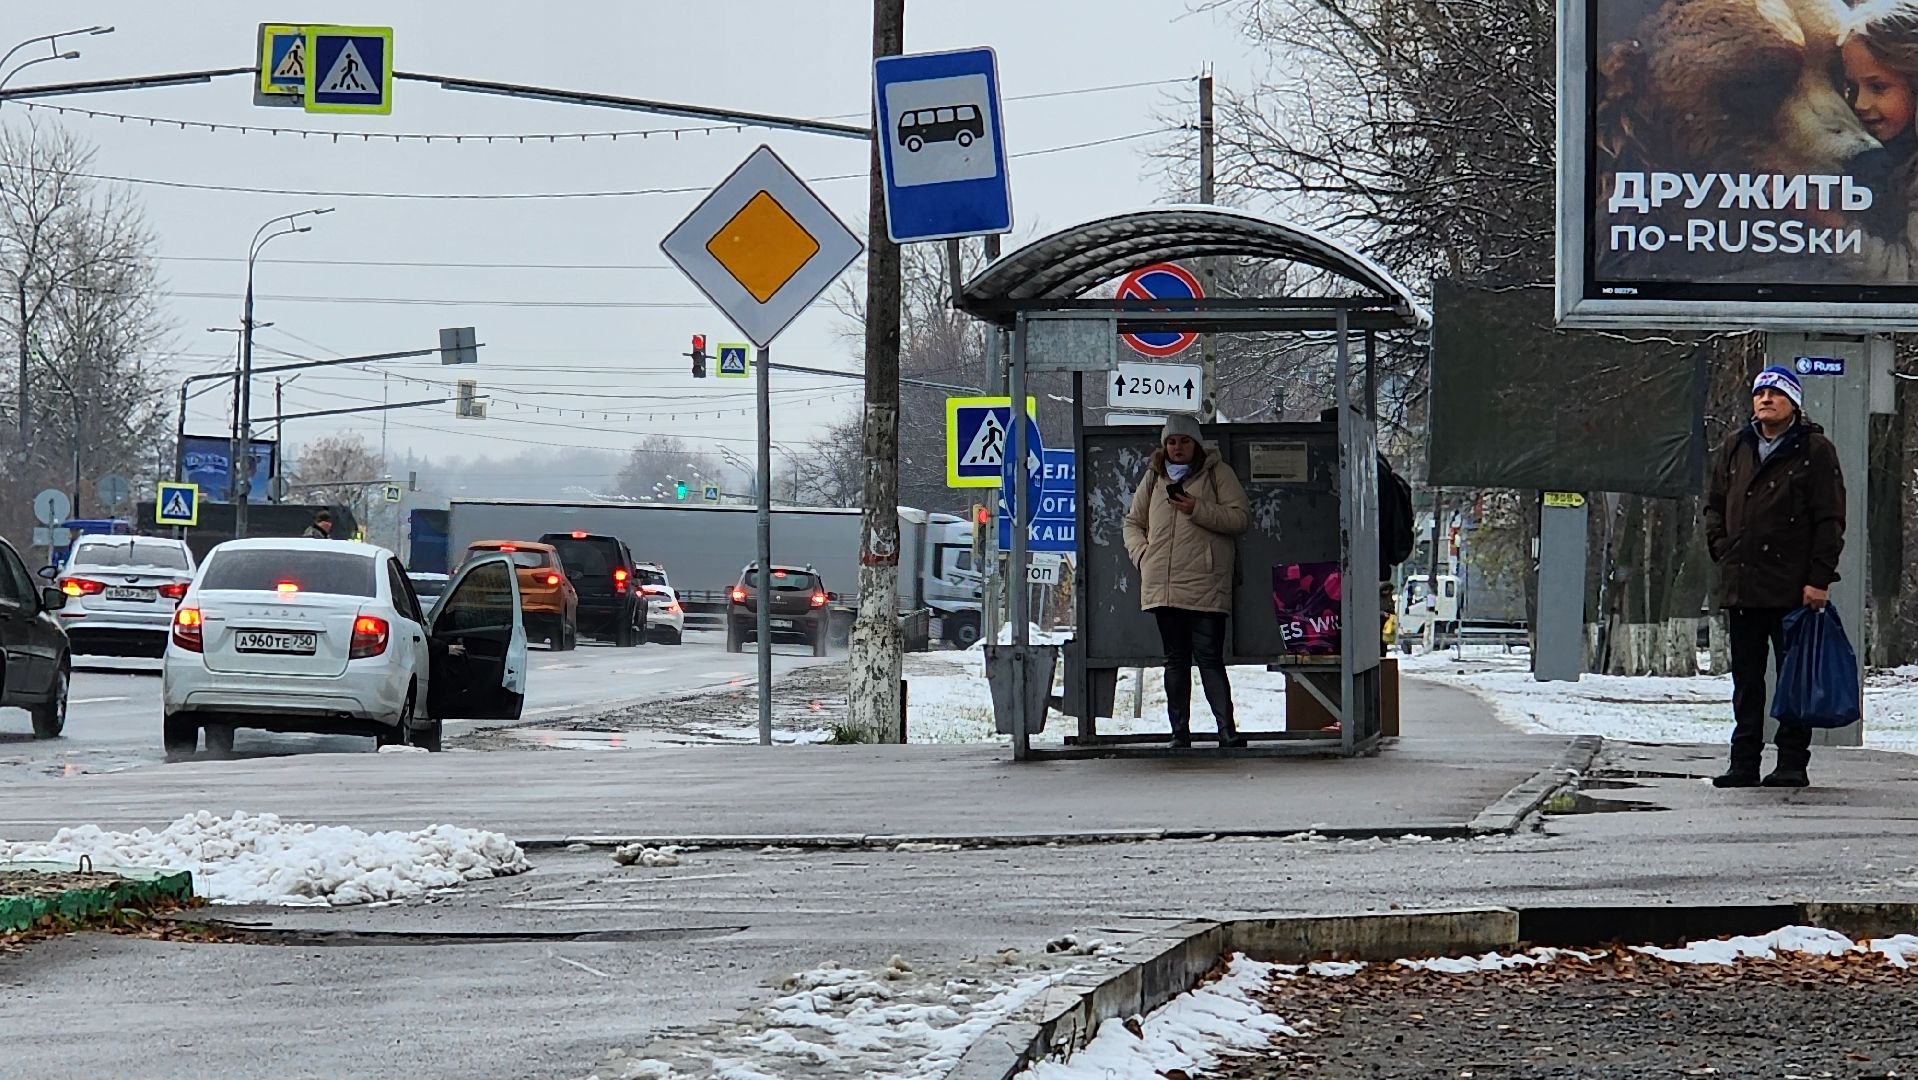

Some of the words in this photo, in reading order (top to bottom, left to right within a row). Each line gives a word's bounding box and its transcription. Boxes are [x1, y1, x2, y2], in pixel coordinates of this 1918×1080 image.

[1608, 172, 1873, 213] ДРУЖИТЬ
[1610, 219, 1862, 254] по-RUSSки
[1813, 361, 1842, 372] Russ
[248, 608, 306, 618] LADA
[240, 634, 290, 648] А960ТЕ
[292, 634, 313, 646] 750
